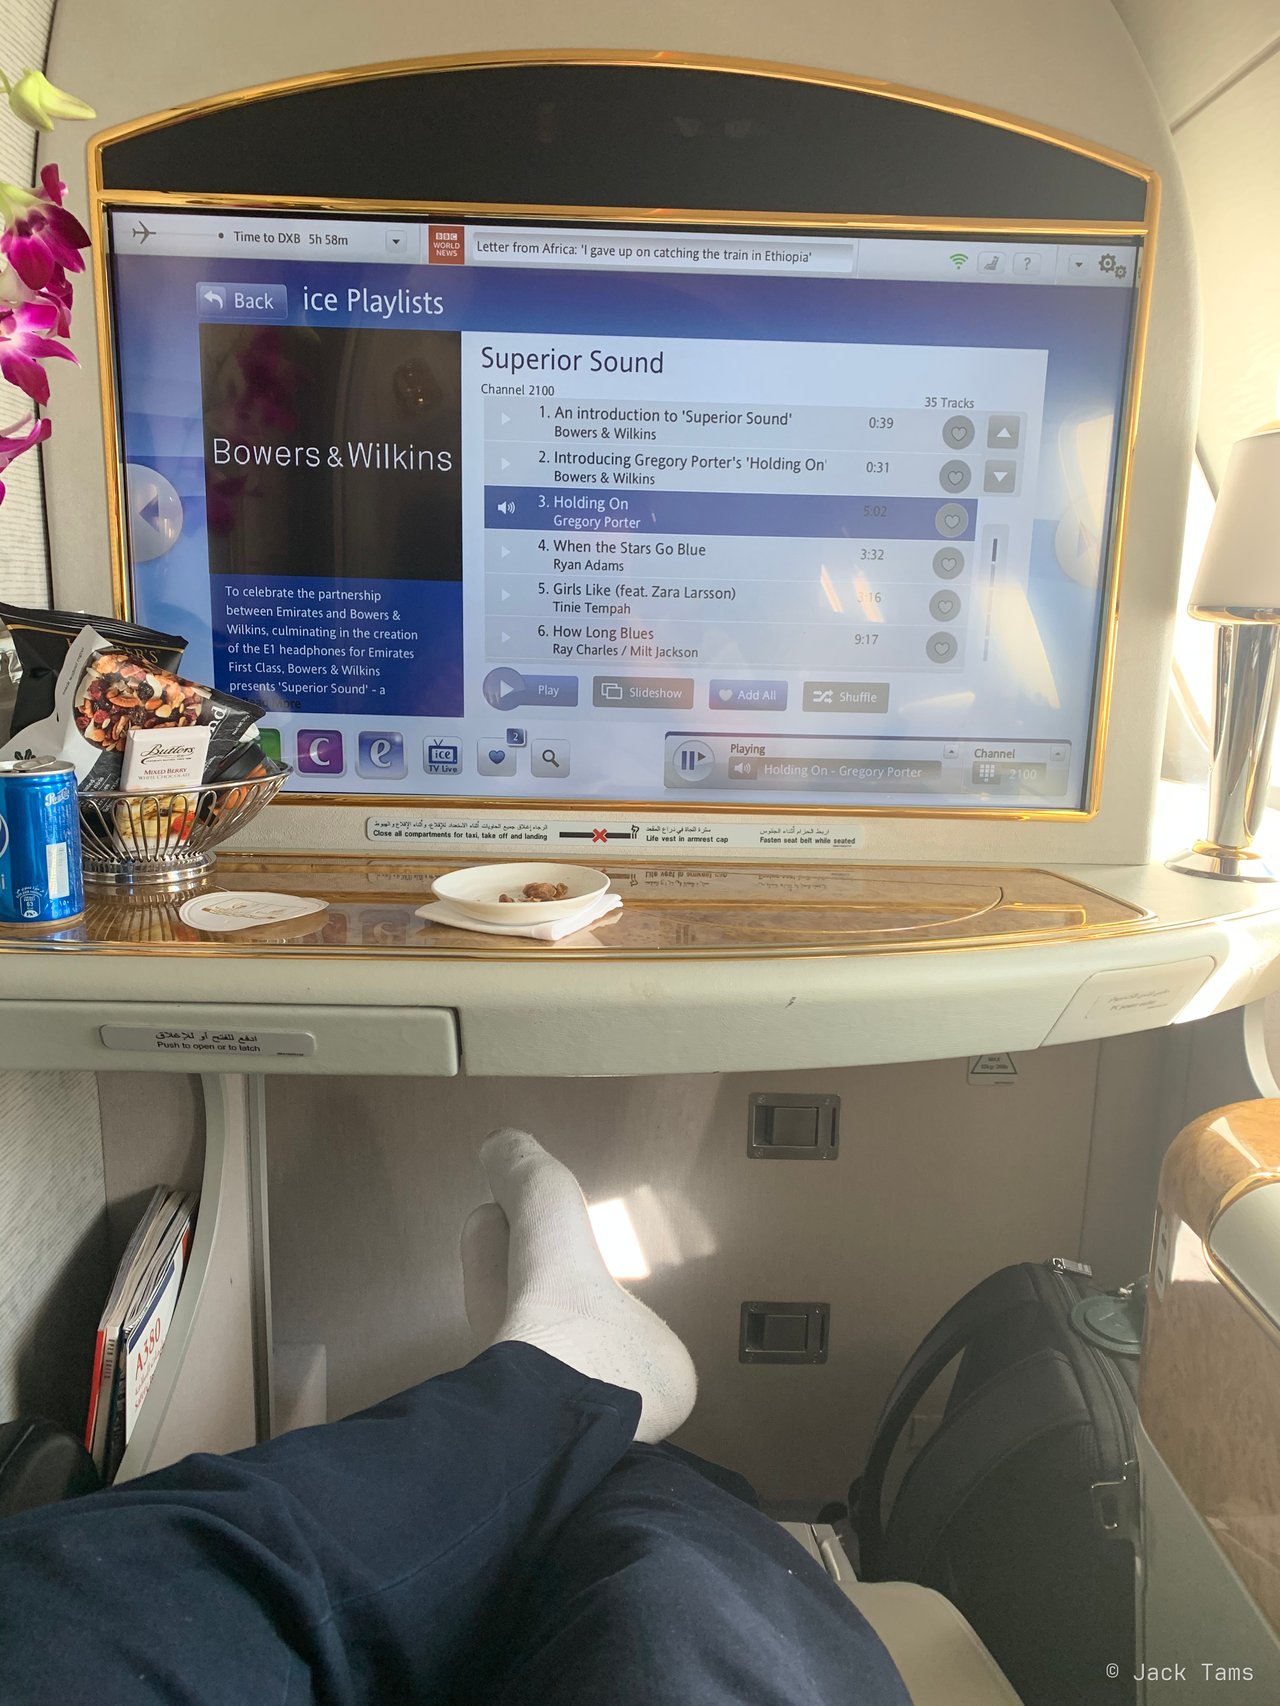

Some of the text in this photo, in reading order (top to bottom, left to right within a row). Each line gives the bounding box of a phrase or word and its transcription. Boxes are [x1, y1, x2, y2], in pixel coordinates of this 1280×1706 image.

[233, 231, 348, 246] Time to DXB 5h 58m
[435, 232, 457, 241] BBC
[433, 242, 460, 250] WORLD
[436, 249, 458, 257] NEWS
[477, 241, 812, 264] Letter from Africa: gave up on catching the train in Ethiopia'
[234, 292, 274, 310] Back
[303, 285, 444, 319] ice Playlists
[481, 347, 664, 374] Superior Sound
[481, 383, 555, 396] Channel 2100
[924, 397, 975, 409] 35 Tracks
[555, 406, 894, 429] An introduction to 'Superior Sound' 0:39
[555, 426, 657, 440] Bowers Wilkins
[213, 438, 452, 472] Bowers & Wilkins
[554, 451, 890, 473] Introducing Gregory Porter's 'Holding 0:31
[554, 471, 655, 485] Bowers Wilkins
[554, 496, 629, 512] Holding On
[553, 515, 641, 530] Gregory Porter
[553, 540, 884, 561] When the Stars Go Blue 3:32
[553, 559, 625, 573] Ryan Adams
[225, 586, 382, 604] To celebrate the partnership
[553, 583, 736, 601] Girls Like (feat. Zara Larsson)
[226, 605, 389, 620] between Emirates and Bowers
[552, 601, 631, 617] Tinie Tempah
[226, 624, 418, 640] Wilkins, culminating in the creation
[553, 625, 879, 645] How Long Blues 9:17
[227, 643, 415, 659] of the E1 headphones for Emirates
[552, 643, 699, 660] Ray Charles Milt Jackson
[228, 662, 380, 676] First Class, Bowers Wilkins
[229, 682, 369, 696] presents 'Superior Sound'
[538, 685, 560, 697] Play
[629, 686, 683, 699] Slideshow
[737, 689, 776, 700] Add All
[839, 690, 877, 703] Shuffle
[434, 750, 451, 759] ice
[730, 743, 766, 756] Playing
[974, 748, 1016, 759] Channel
[428, 765, 458, 773] TV Live
[764, 764, 922, 780] Holding On Gregory Porter
[1009, 768, 1037, 780] 2100
[525, 833, 547, 841] landing
